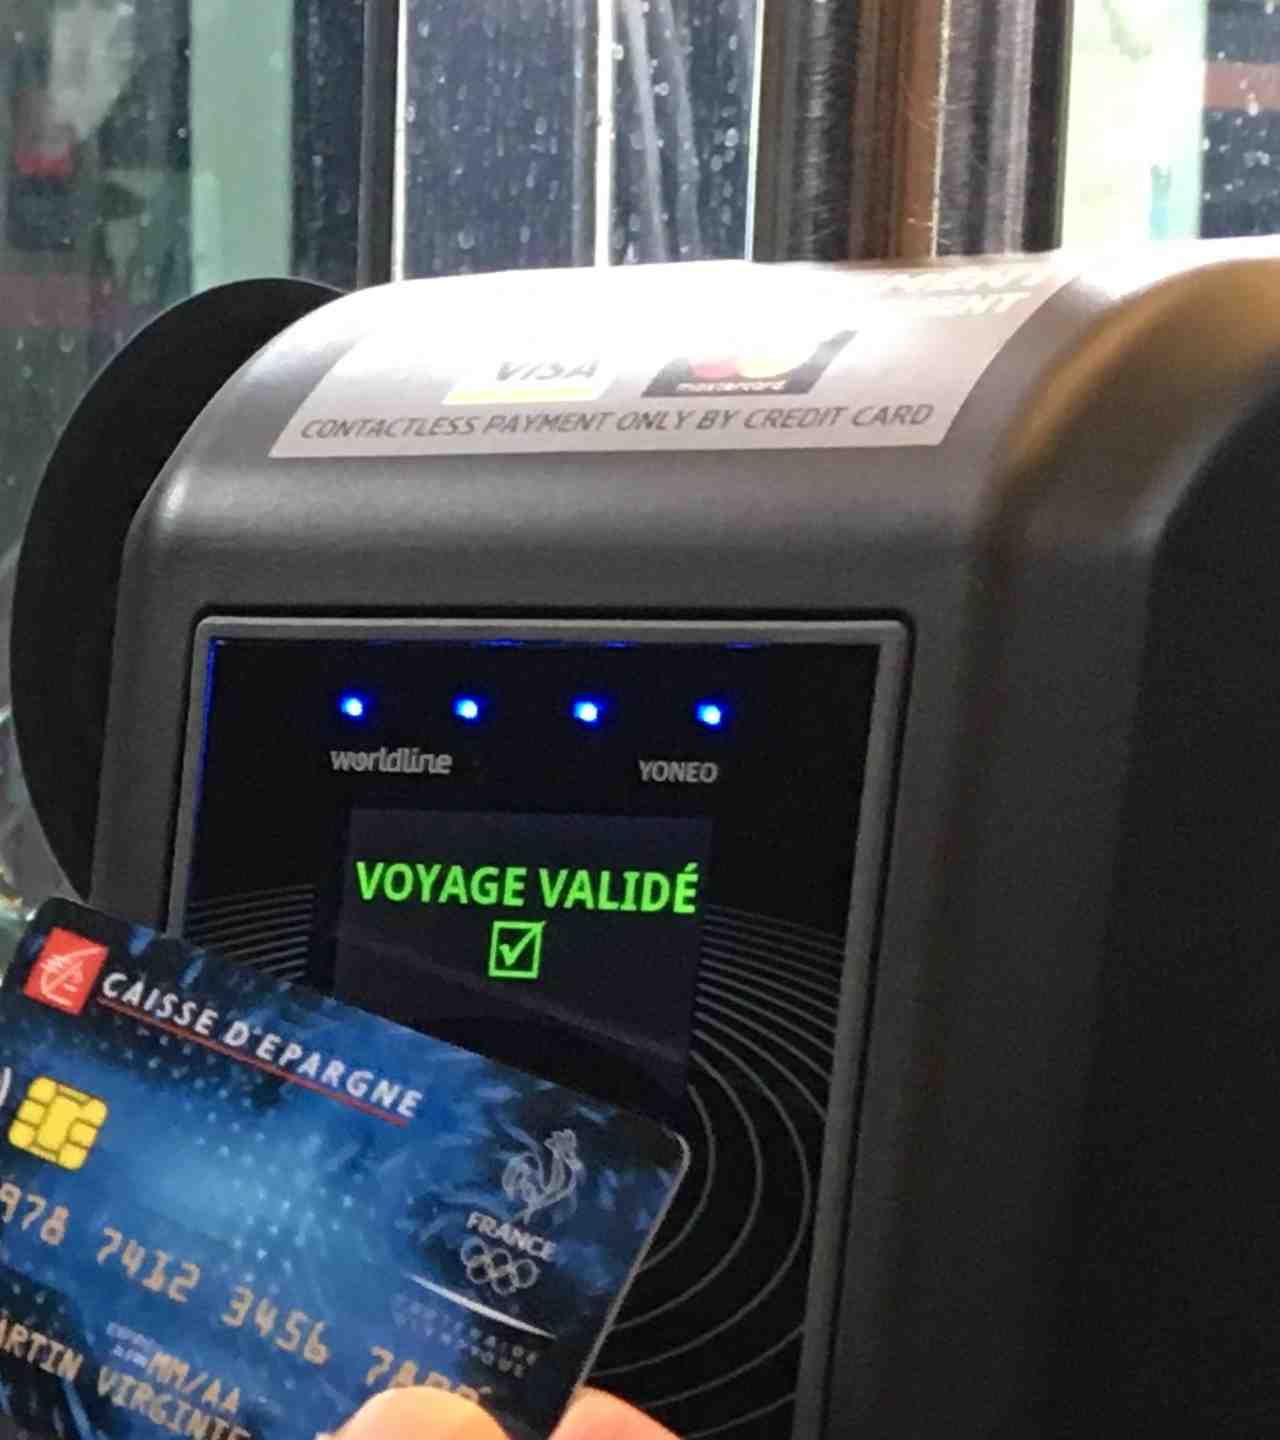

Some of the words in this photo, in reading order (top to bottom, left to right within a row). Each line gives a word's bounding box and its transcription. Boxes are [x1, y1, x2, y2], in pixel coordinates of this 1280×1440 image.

[496, 361, 601, 381] VISA
[301, 416, 481, 439] CONTACTLESS
[482, 411, 616, 434] PAYMENT
[615, 409, 696, 432] ONLY
[696, 409, 739, 431] BY
[743, 406, 849, 430] CREDIT
[851, 403, 935, 427] CARD
[330, 747, 452, 776] worldline
[638, 758, 718, 783] YONEO
[356, 860, 527, 907] VOYAGE
[539, 863, 700, 915] VALIDÉ
[101, 972, 219, 1036] CAISSE
[223, 1020, 424, 1118] D'EPARGNE
[466, 1210, 557, 1262] FRANCE
[96, 1226, 201, 1303] 7412
[220, 1285, 329, 1366] 3456
